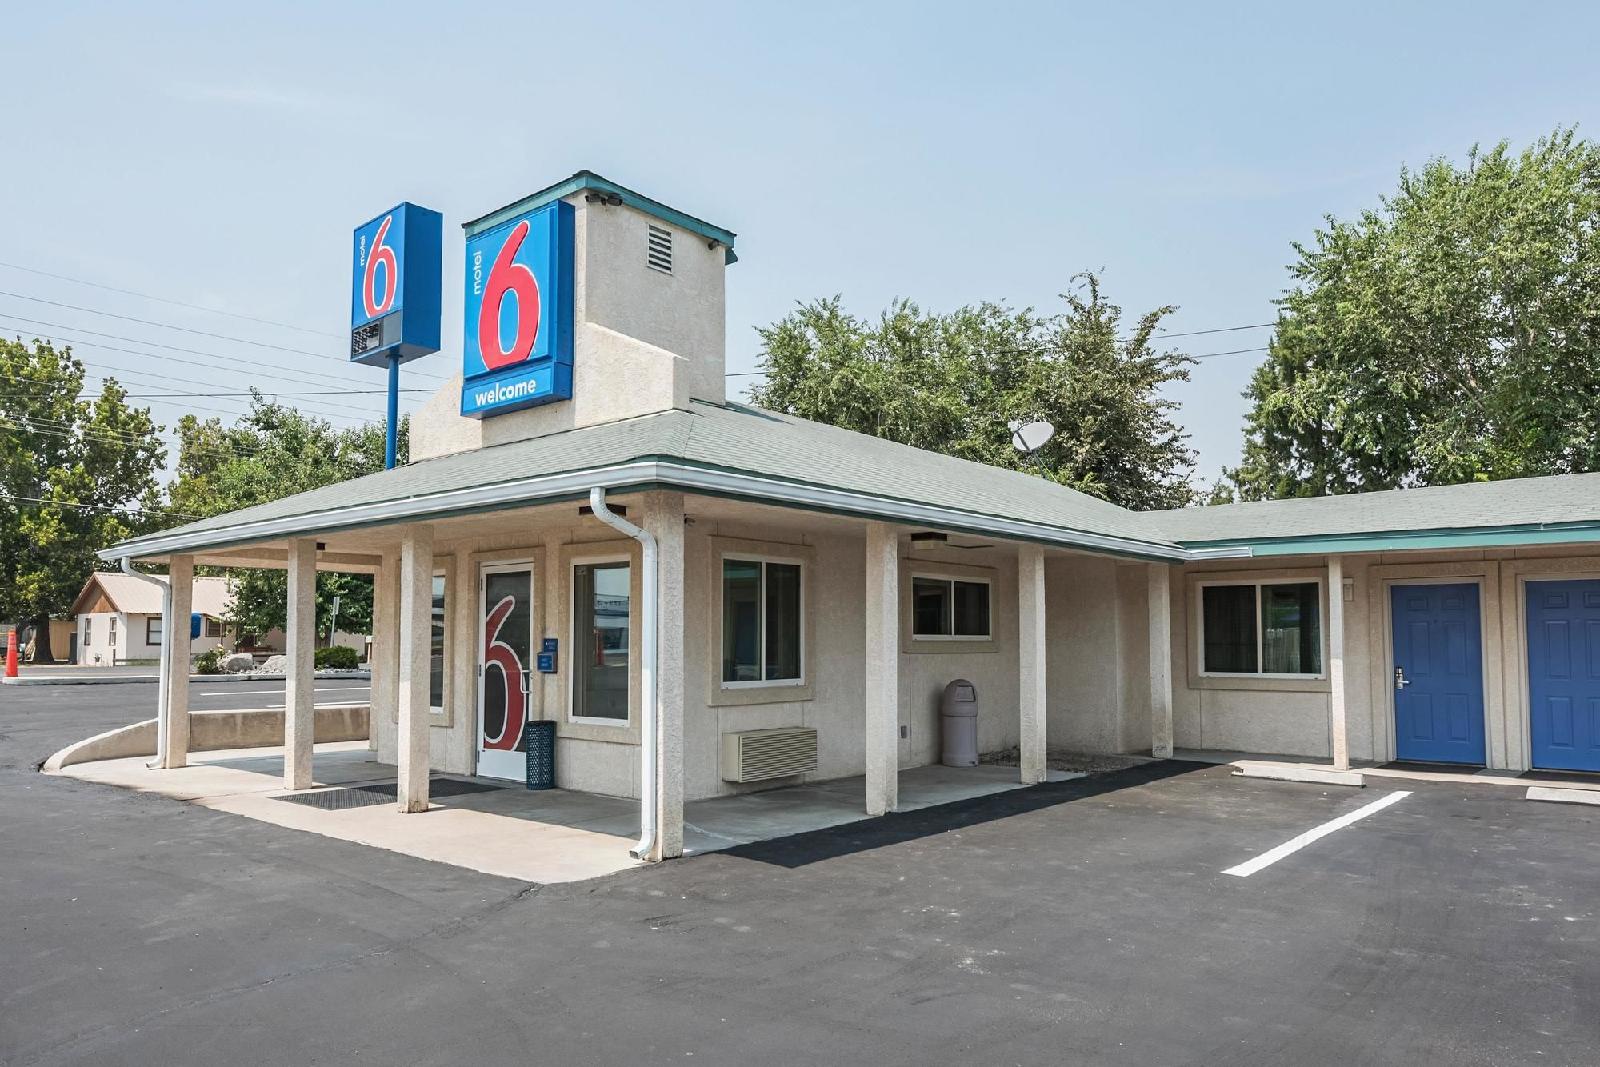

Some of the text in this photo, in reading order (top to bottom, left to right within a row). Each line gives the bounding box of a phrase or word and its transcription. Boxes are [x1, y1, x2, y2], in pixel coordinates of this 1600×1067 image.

[363, 215, 397, 319] 6
[474, 220, 540, 370] motel 6
[475, 380, 536, 406] welcome
[484, 595, 525, 751] 6
